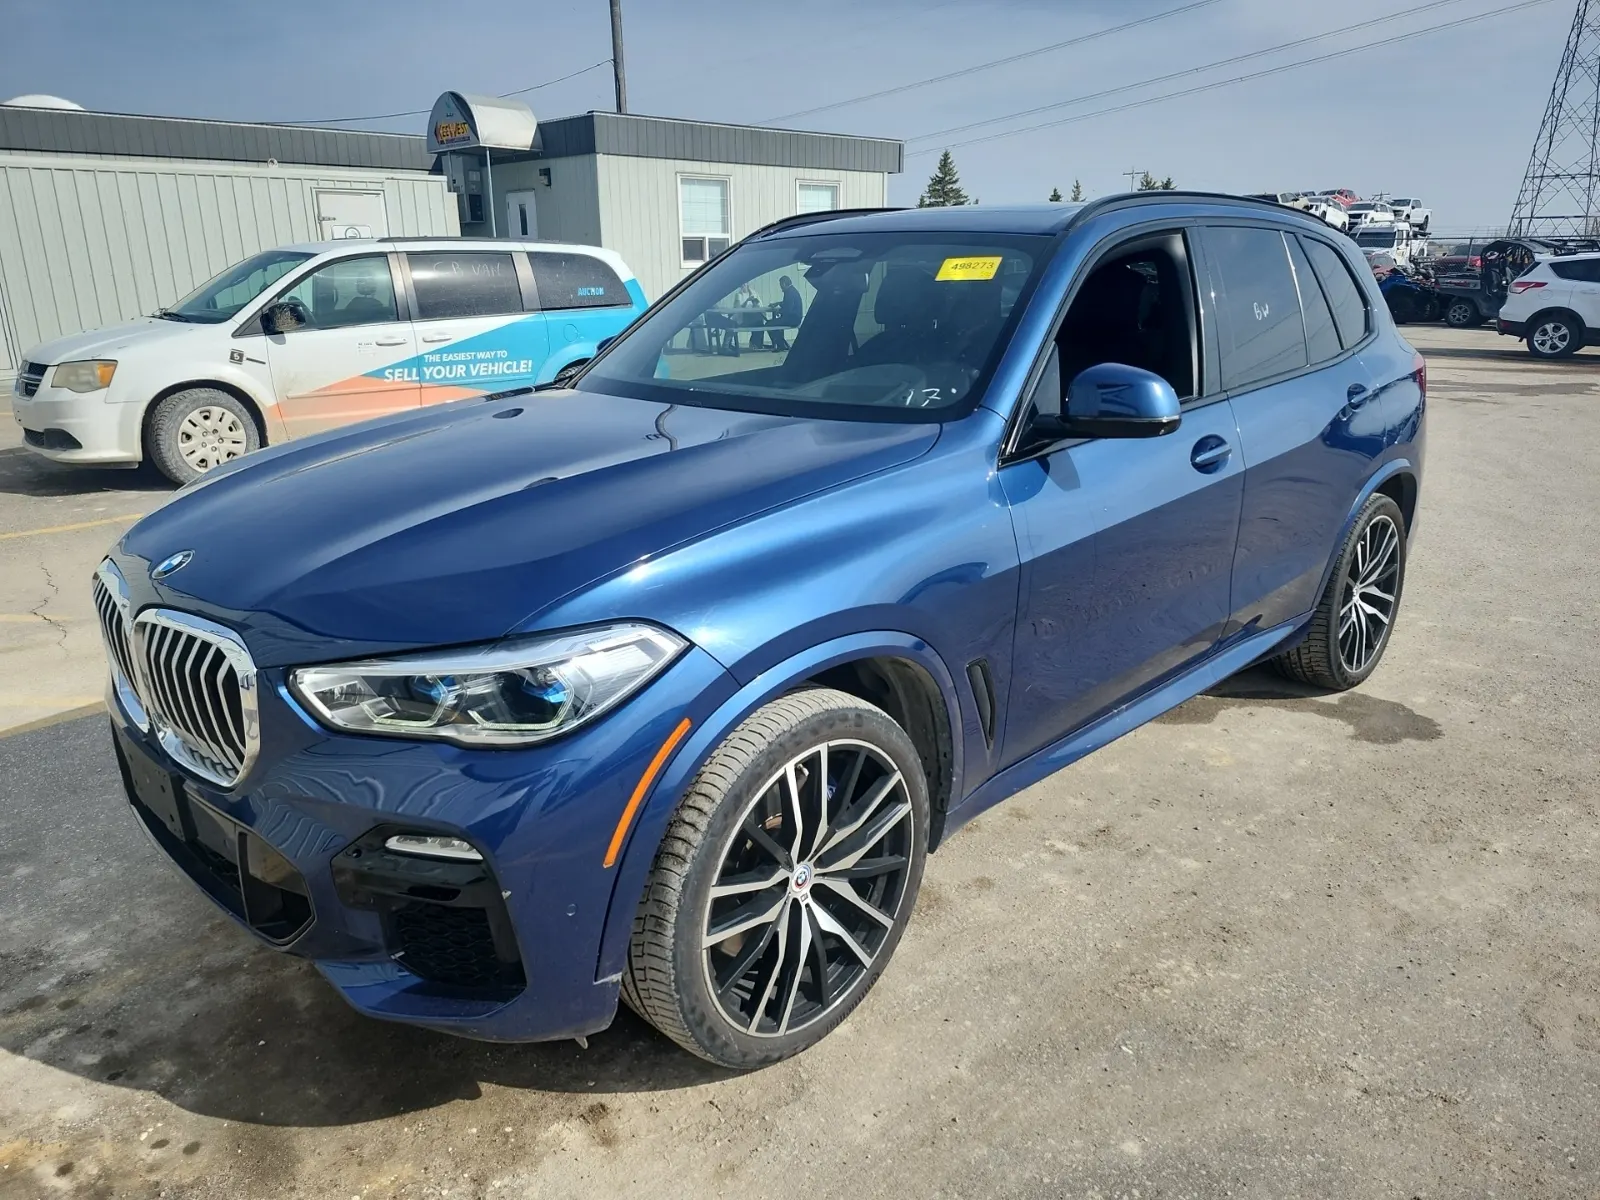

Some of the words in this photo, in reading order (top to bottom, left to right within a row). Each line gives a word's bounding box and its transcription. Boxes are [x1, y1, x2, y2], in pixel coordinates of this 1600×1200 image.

[471, 261, 500, 278] VAN
[951, 261, 994, 270] 498273
[424, 354, 441, 363] THE
[442, 351, 476, 362] EASIEST
[477, 350, 496, 360] WAY
[497, 349, 508, 359] TO
[383, 367, 420, 382] SELL
[423, 364, 467, 380] YOUR
[469, 359, 533, 377] VEHICLE!
